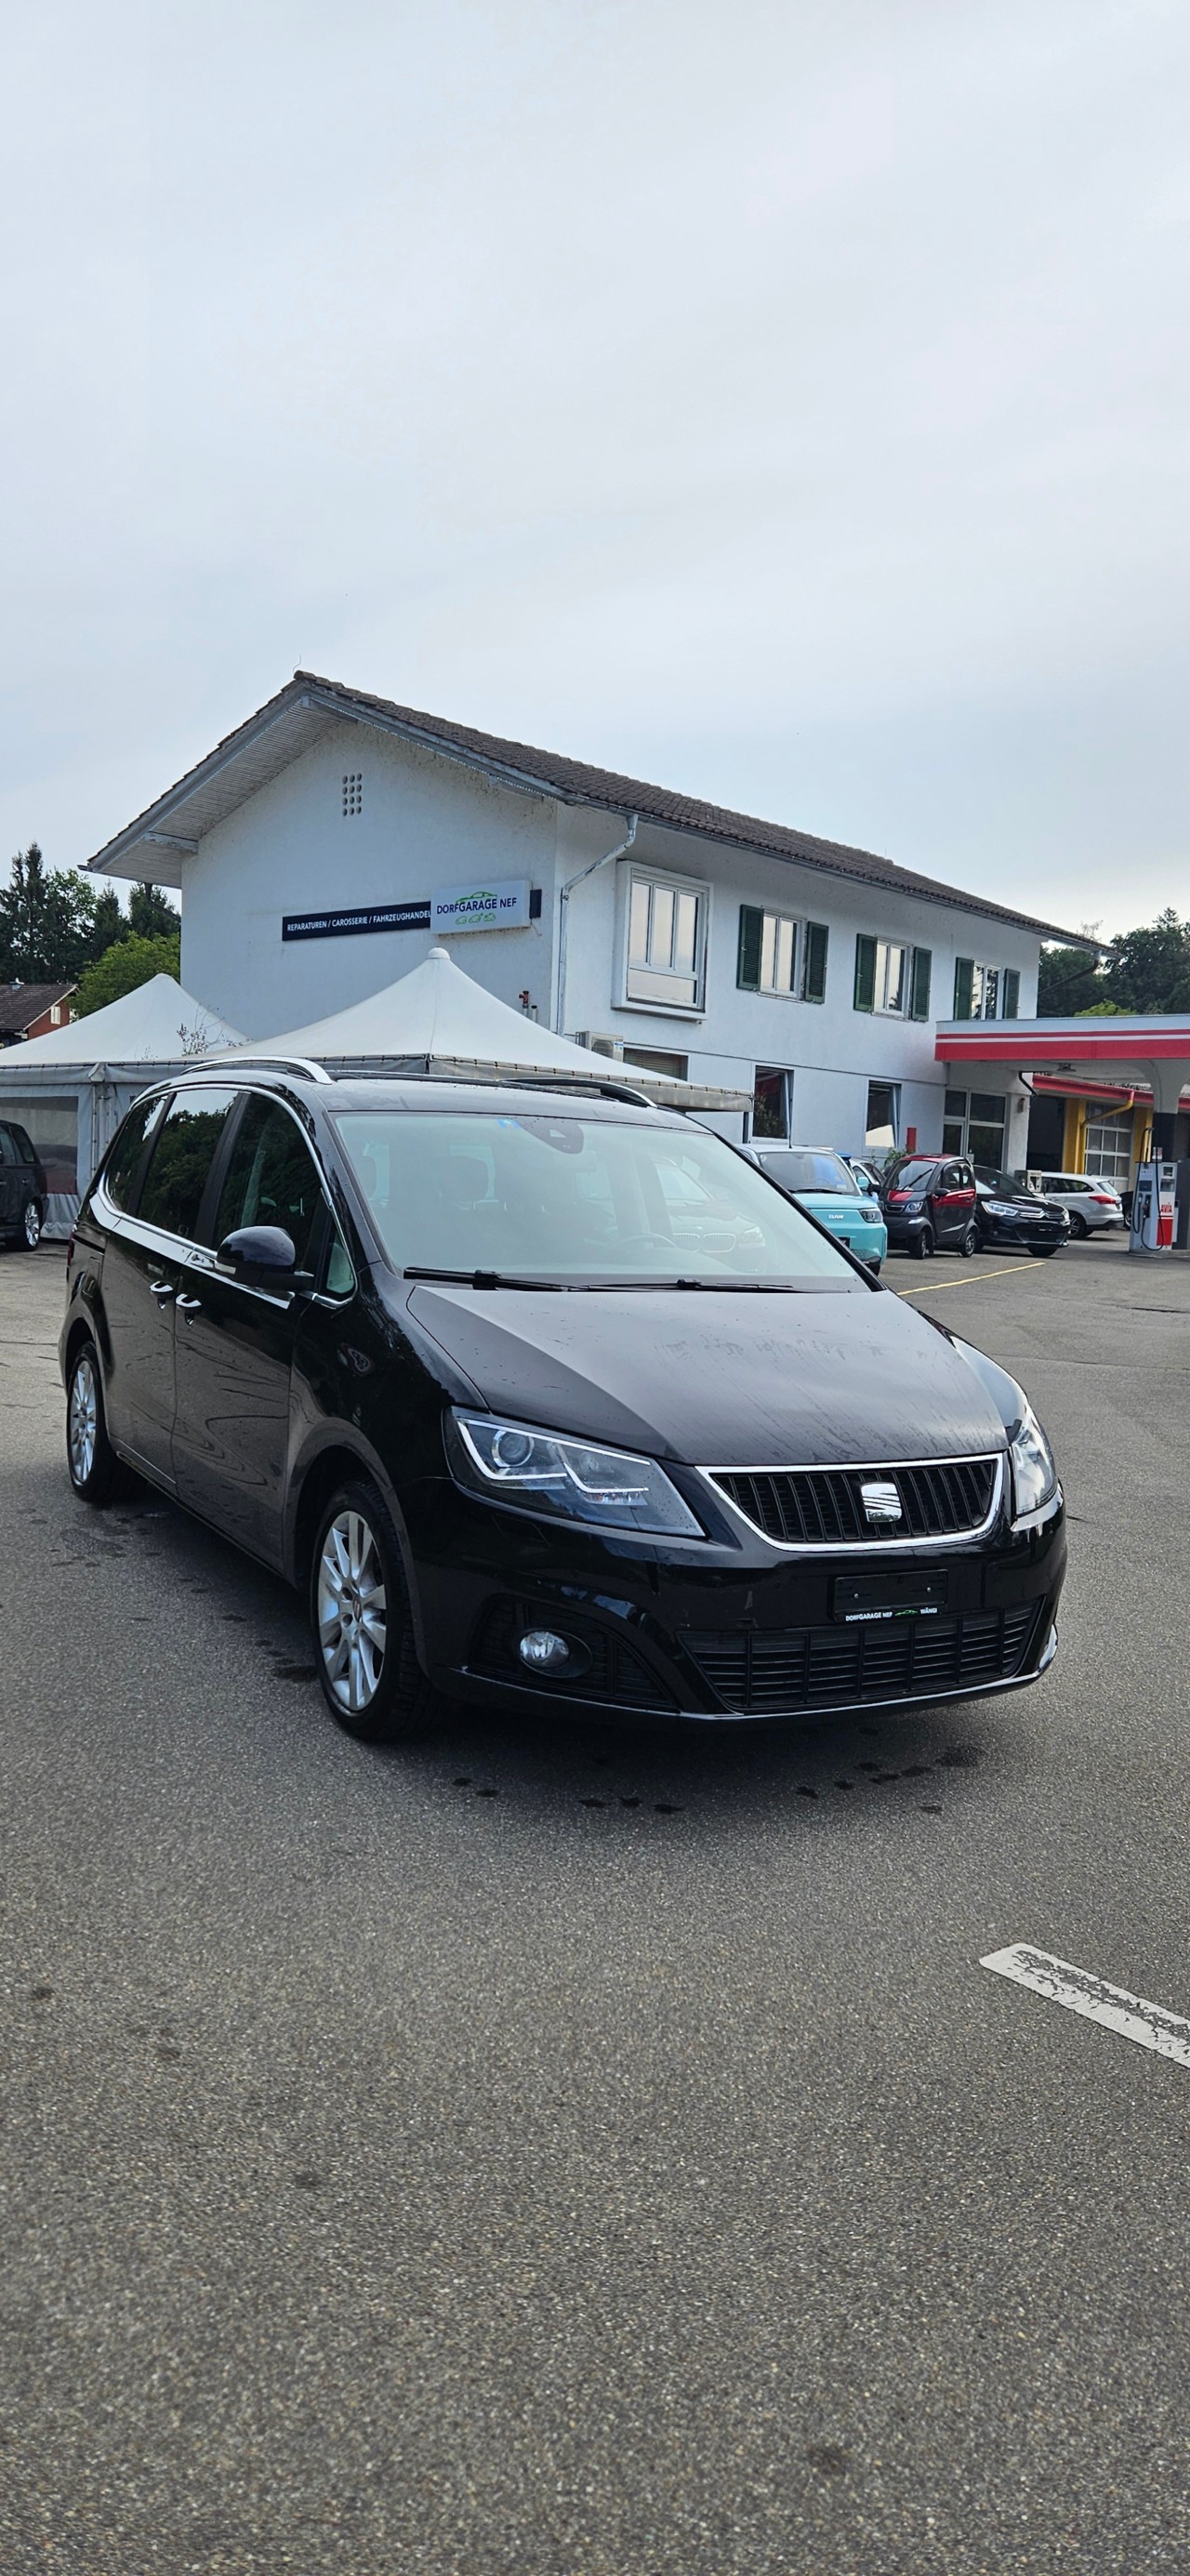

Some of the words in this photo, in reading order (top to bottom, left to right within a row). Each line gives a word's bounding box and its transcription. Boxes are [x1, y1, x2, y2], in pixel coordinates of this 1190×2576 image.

[436, 898, 497, 914] DORFGARAGE
[499, 897, 517, 908] NEF
[286, 920, 327, 931] REPARATUREN
[331, 916, 368, 928] CAROSSERIE
[373, 910, 431, 923] FAHRZEUGHANDEL
[845, 1612, 882, 1621] DORFGARAGE
